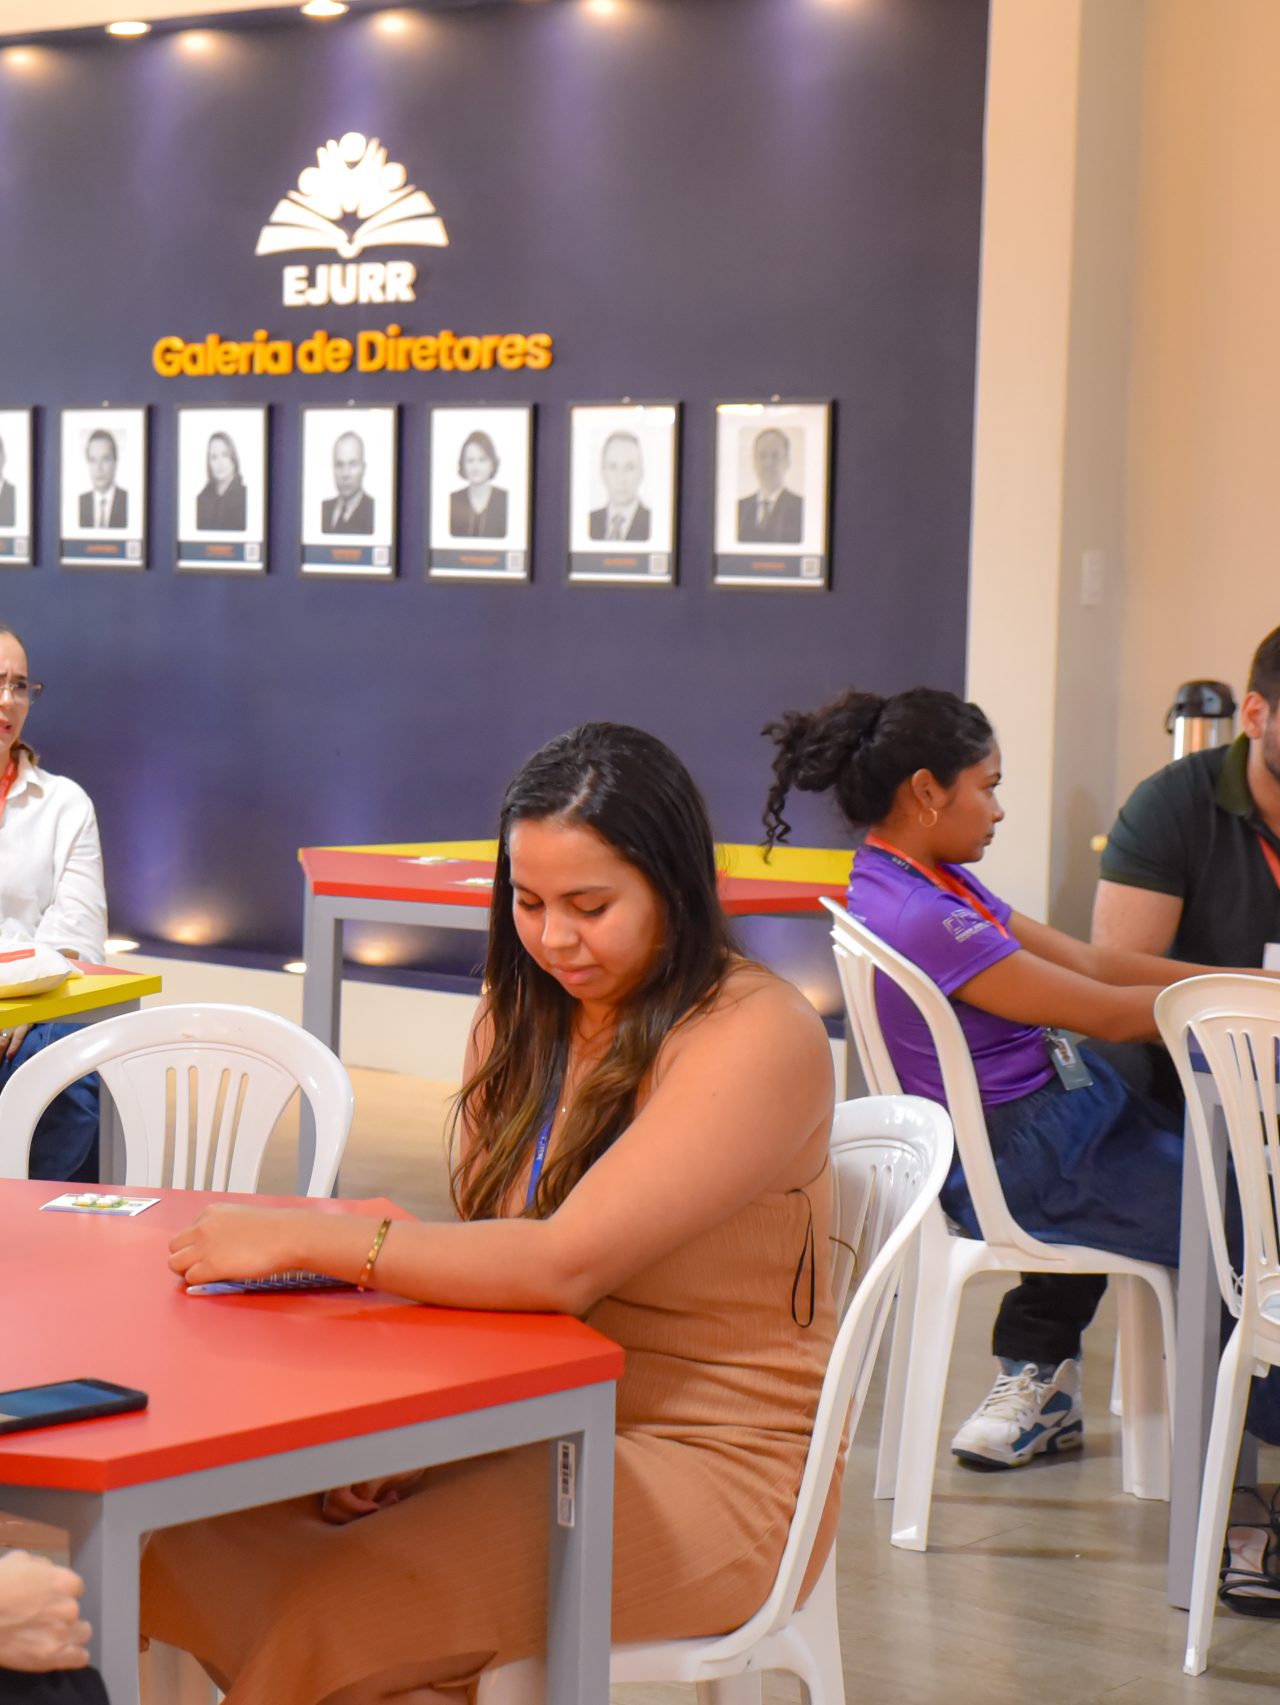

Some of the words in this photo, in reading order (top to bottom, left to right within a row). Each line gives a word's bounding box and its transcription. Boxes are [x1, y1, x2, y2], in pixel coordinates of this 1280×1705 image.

[283, 261, 417, 306] EJURR
[152, 329, 293, 377] Galeria
[296, 330, 353, 373] de
[357, 324, 553, 372] Diretores
